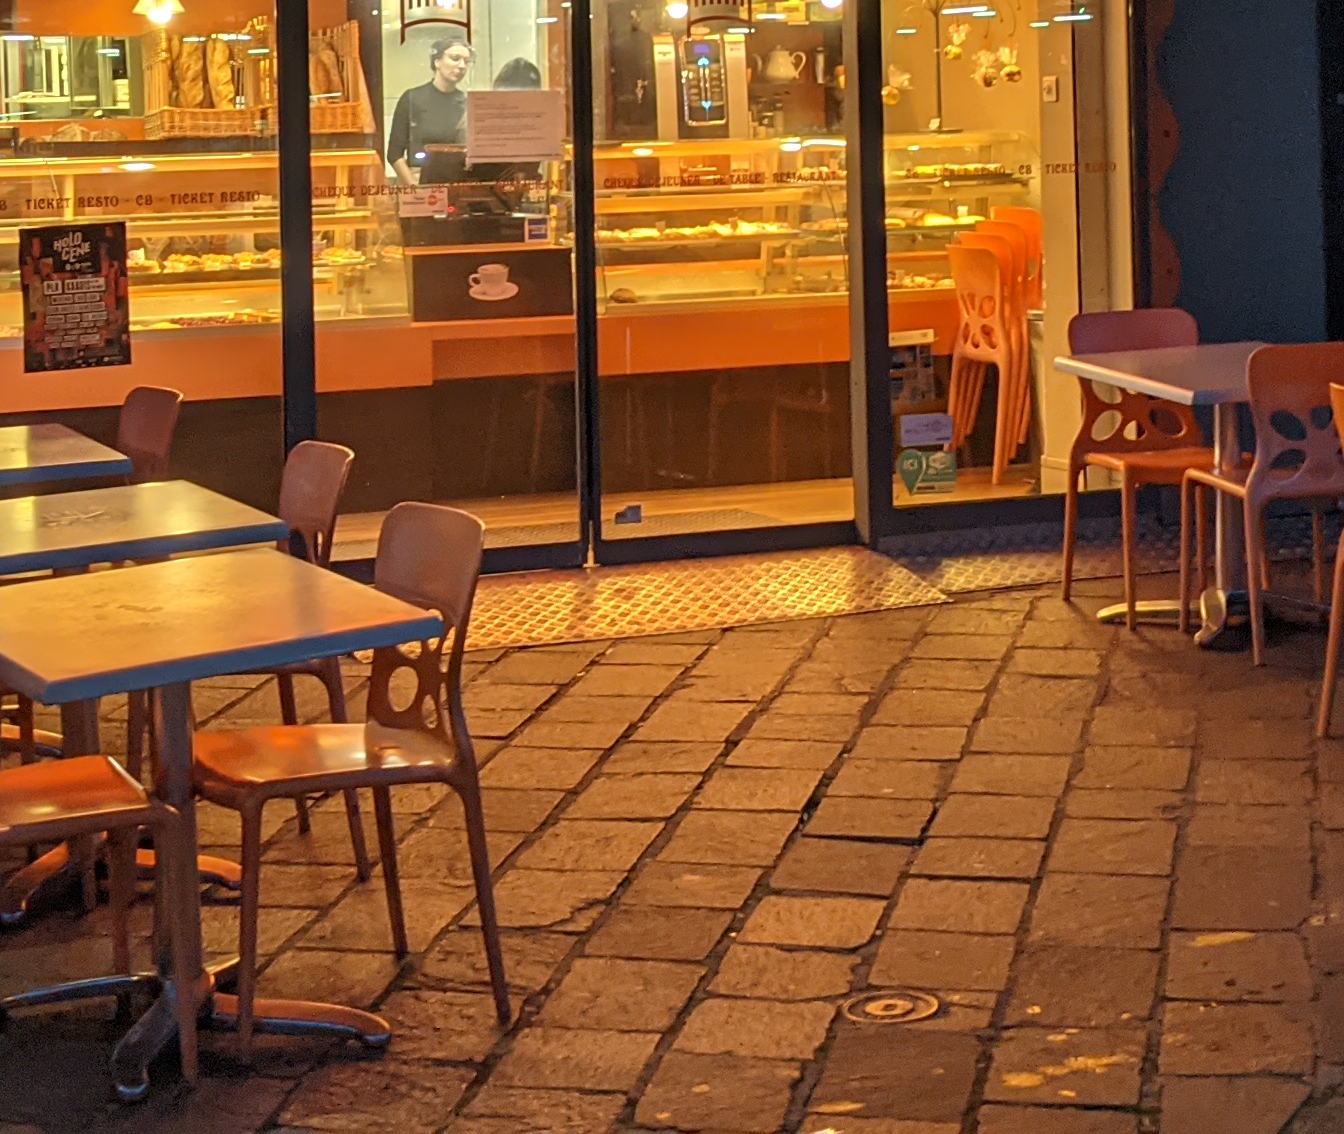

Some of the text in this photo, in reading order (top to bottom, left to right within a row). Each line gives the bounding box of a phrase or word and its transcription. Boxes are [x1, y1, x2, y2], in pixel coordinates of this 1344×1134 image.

[313, 185, 356, 197] CHEQUE
[360, 183, 417, 195] DEJEUNER
[25, 197, 71, 210] TICKET
[77, 195, 119, 208] RESTO
[136, 194, 153, 206] CB
[170, 192, 214, 205] TICKET
[221, 190, 260, 203] RESTO
